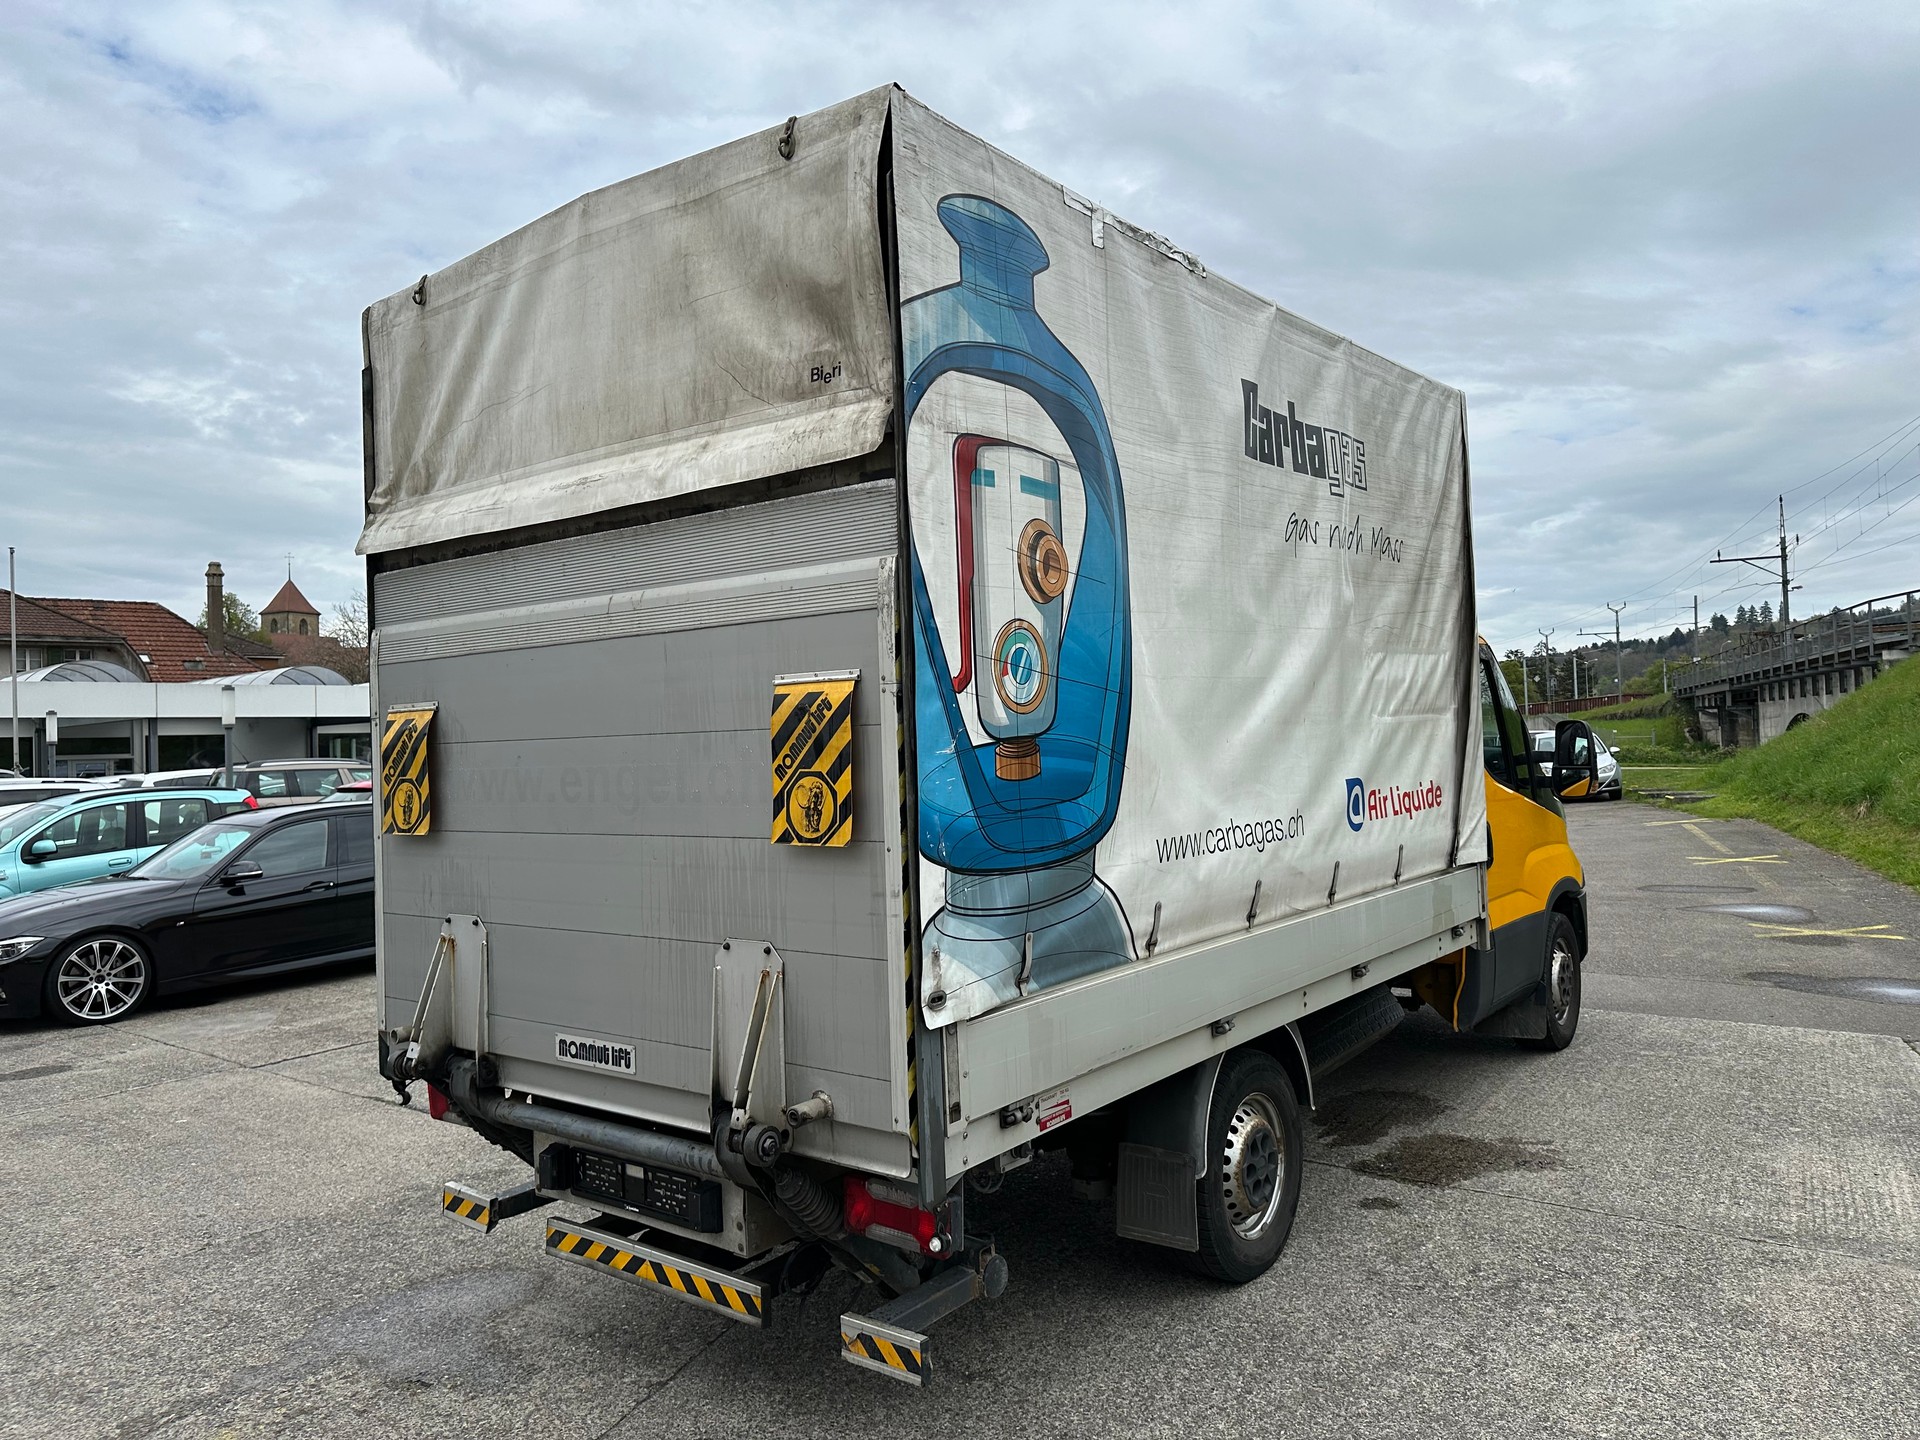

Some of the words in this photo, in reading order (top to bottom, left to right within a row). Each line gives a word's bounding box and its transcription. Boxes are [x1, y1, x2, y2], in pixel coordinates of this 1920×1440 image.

[811, 361, 841, 384] Bieri
[1241, 378, 1367, 498] Carbagas
[1284, 511, 1320, 558] Gas
[774, 716, 817, 782] mammut
[810, 697, 832, 726] lift
[1368, 789, 1388, 821] Air
[1389, 780, 1442, 820] Liquide
[1156, 808, 1304, 863] www.carbagas.ch
[559, 1038, 610, 1065] mammut
[611, 1046, 631, 1070] lift
